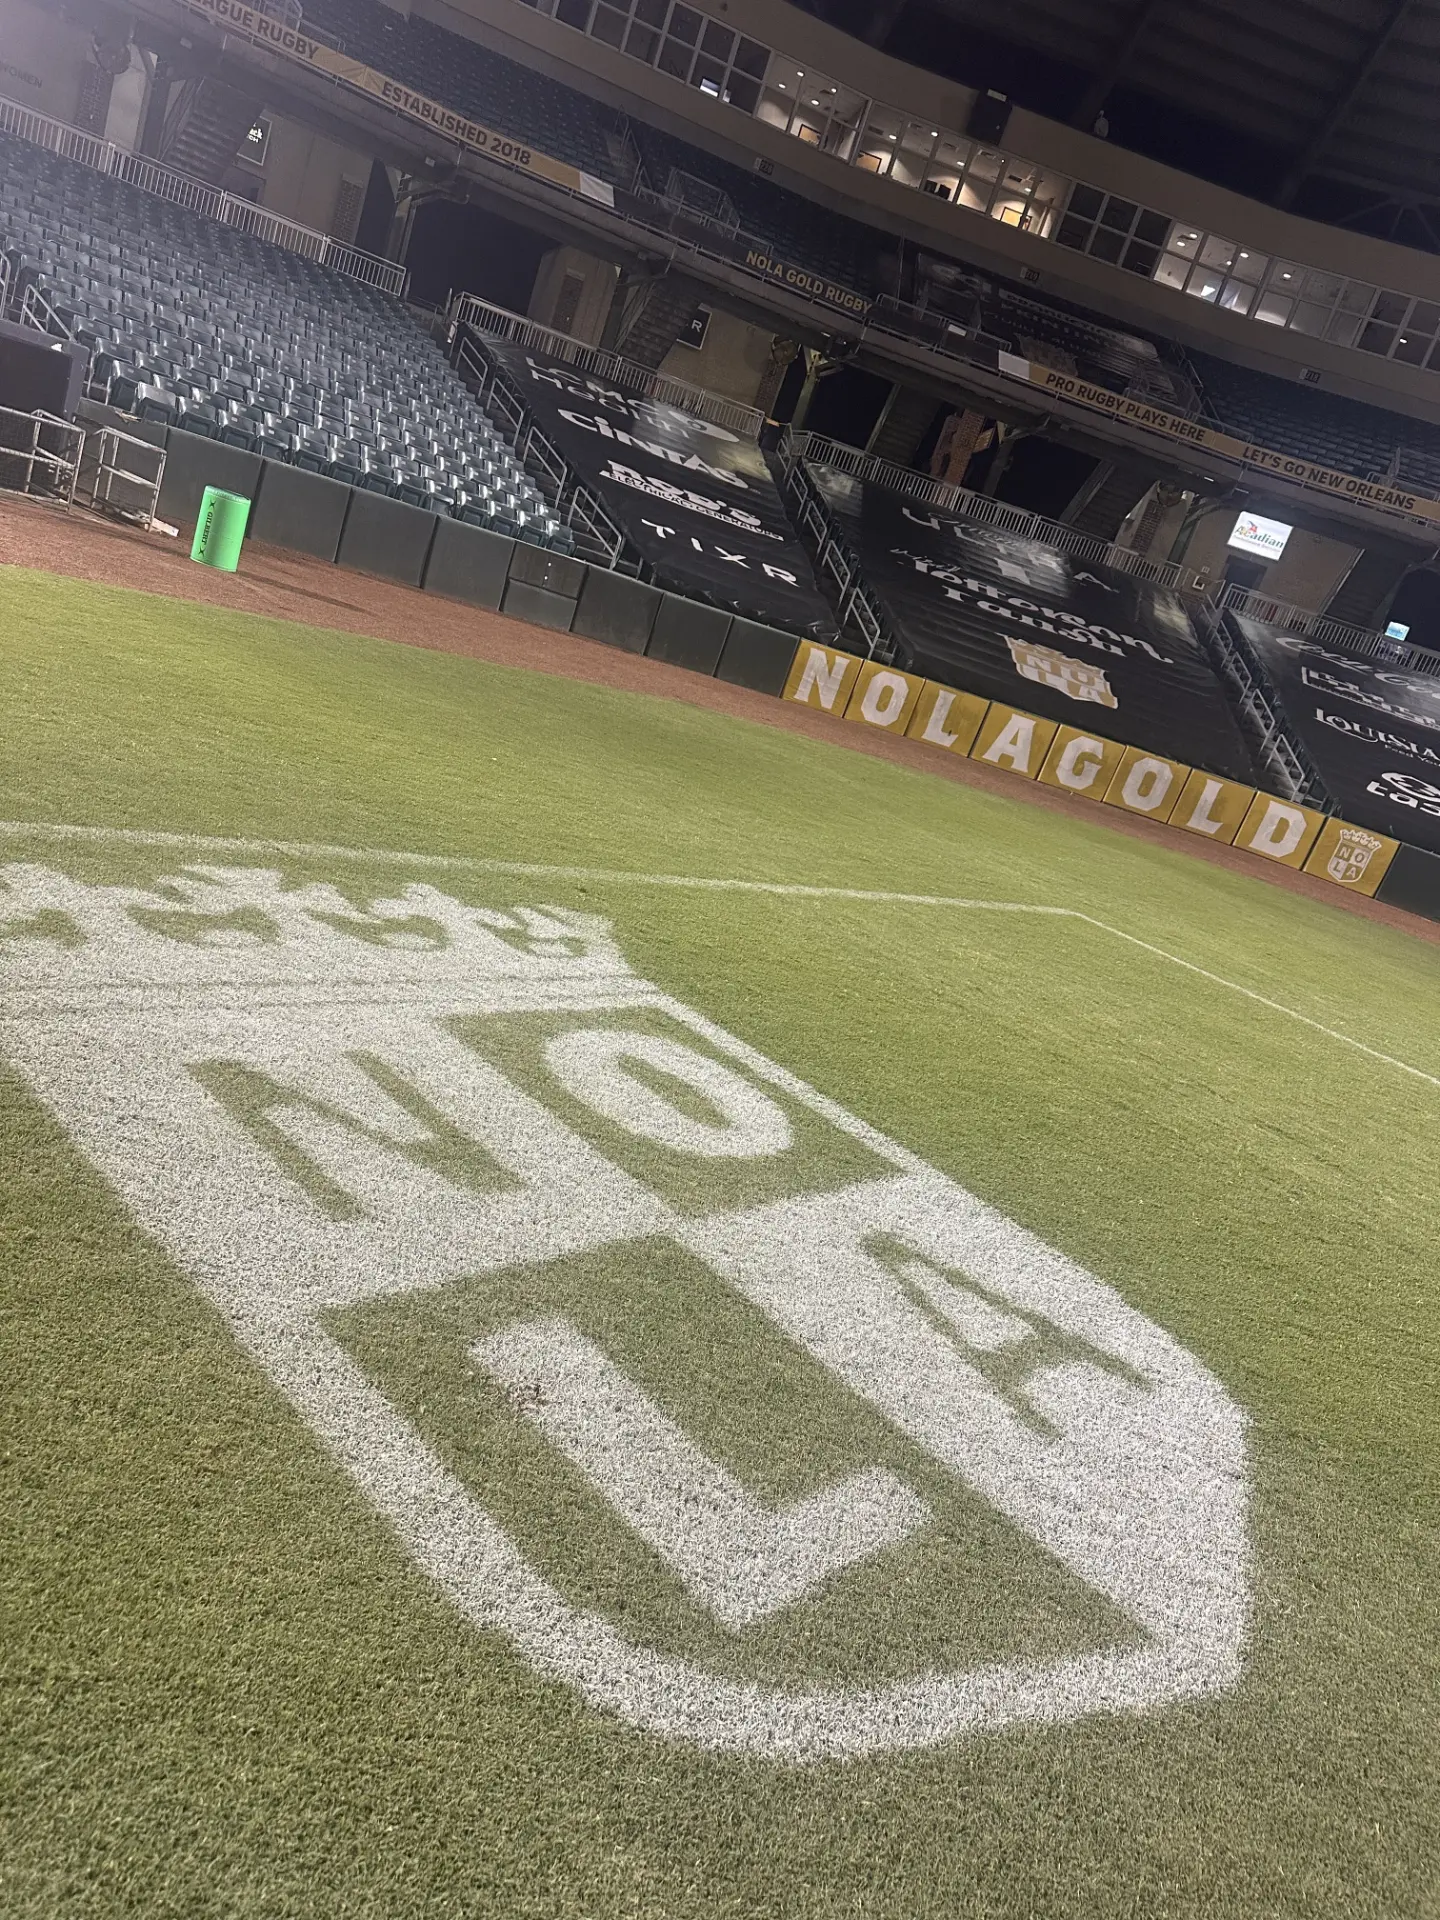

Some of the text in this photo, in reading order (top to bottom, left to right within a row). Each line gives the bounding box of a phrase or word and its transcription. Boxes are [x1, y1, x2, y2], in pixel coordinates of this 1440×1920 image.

[257, 18, 320, 59] RUGBY
[381, 81, 531, 165] ESTABLISHED 2018
[746, 250, 872, 314] NOLA GOLD RUGBY
[531, 369, 690, 439] Health
[1045, 373, 1206, 442] PRO RUGBY PLAYS HERE
[1243, 446, 1416, 511] LET'S GO NEW ORLEANS
[201, 511, 213, 545] GILBERT
[641, 518, 800, 588] TIXR
[1234, 526, 1284, 548] Acadian
